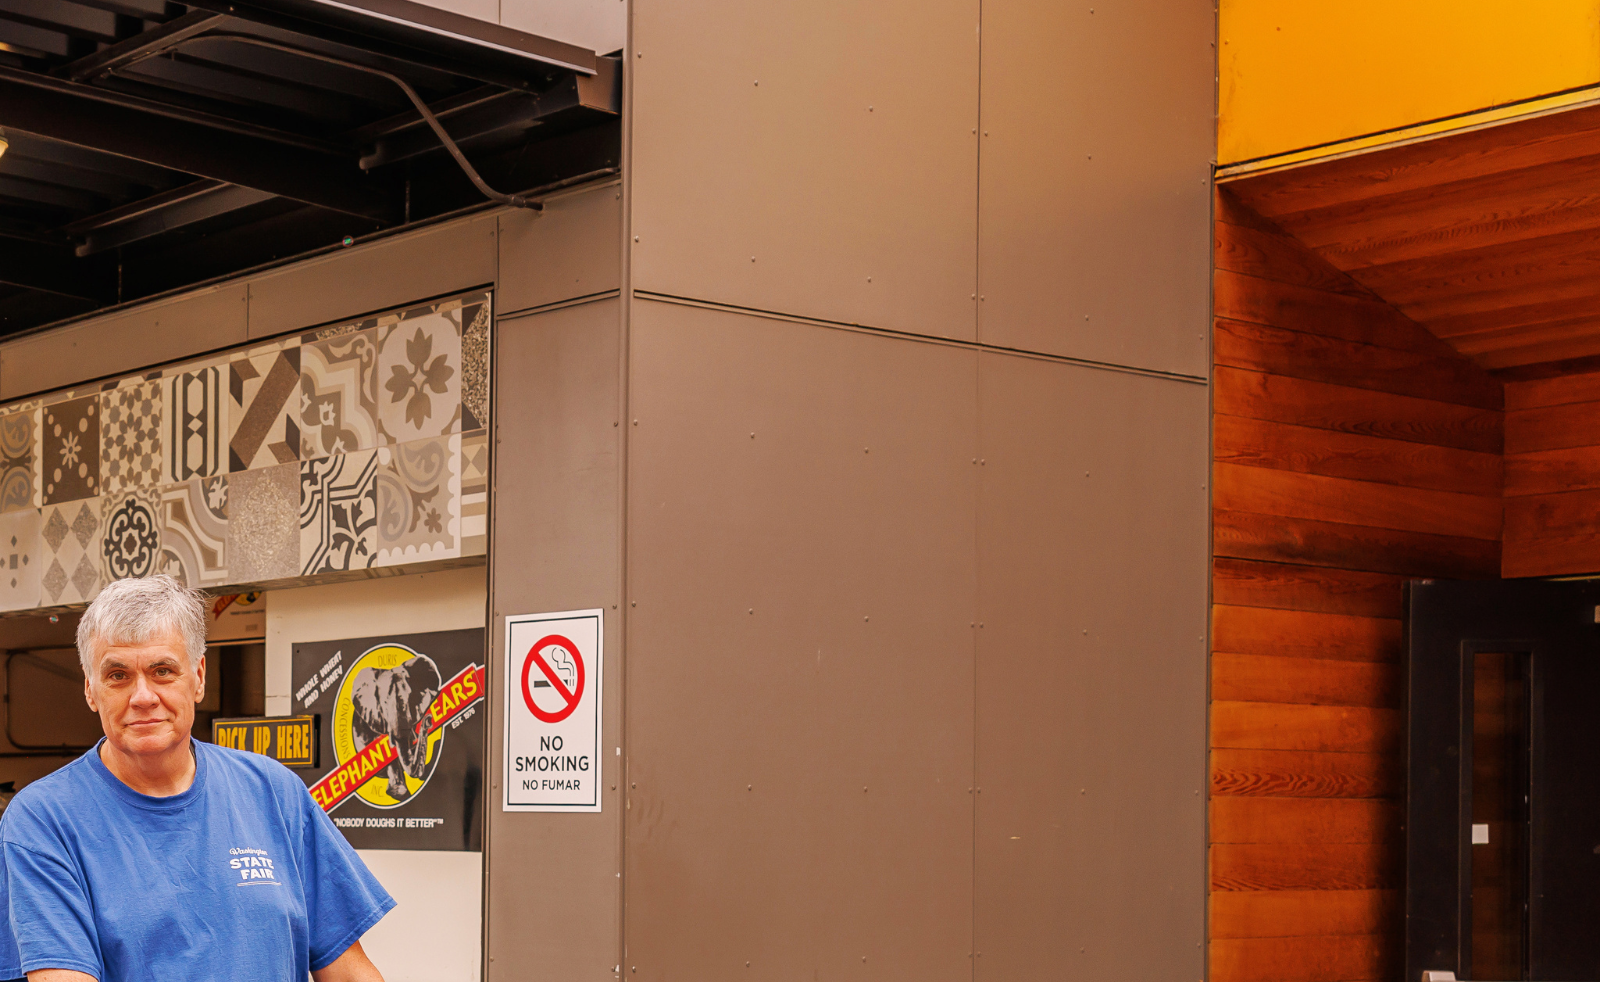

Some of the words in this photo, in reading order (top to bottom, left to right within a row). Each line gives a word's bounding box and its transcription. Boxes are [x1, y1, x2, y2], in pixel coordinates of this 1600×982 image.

[377, 653, 398, 668] DURIS
[295, 673, 319, 702] WHOLE
[319, 650, 342, 678] WHEAT
[304, 689, 319, 709] AND
[320, 664, 343, 692] HONEY
[339, 697, 351, 760] CONCESSIONS
[253, 726, 271, 755] UP
[277, 724, 309, 759] HERE
[311, 735, 392, 808] ELEPHANT
[429, 669, 477, 724] EARS
[540, 735, 563, 752] NO
[515, 755, 589, 772] SMOKING
[522, 779, 539, 791] NO
[542, 779, 581, 791] FUMAR
[366, 817, 396, 828] DOUGHS
[396, 817, 404, 828] IT
[229, 856, 275, 869] STATE
[240, 868, 275, 880] FAIR
